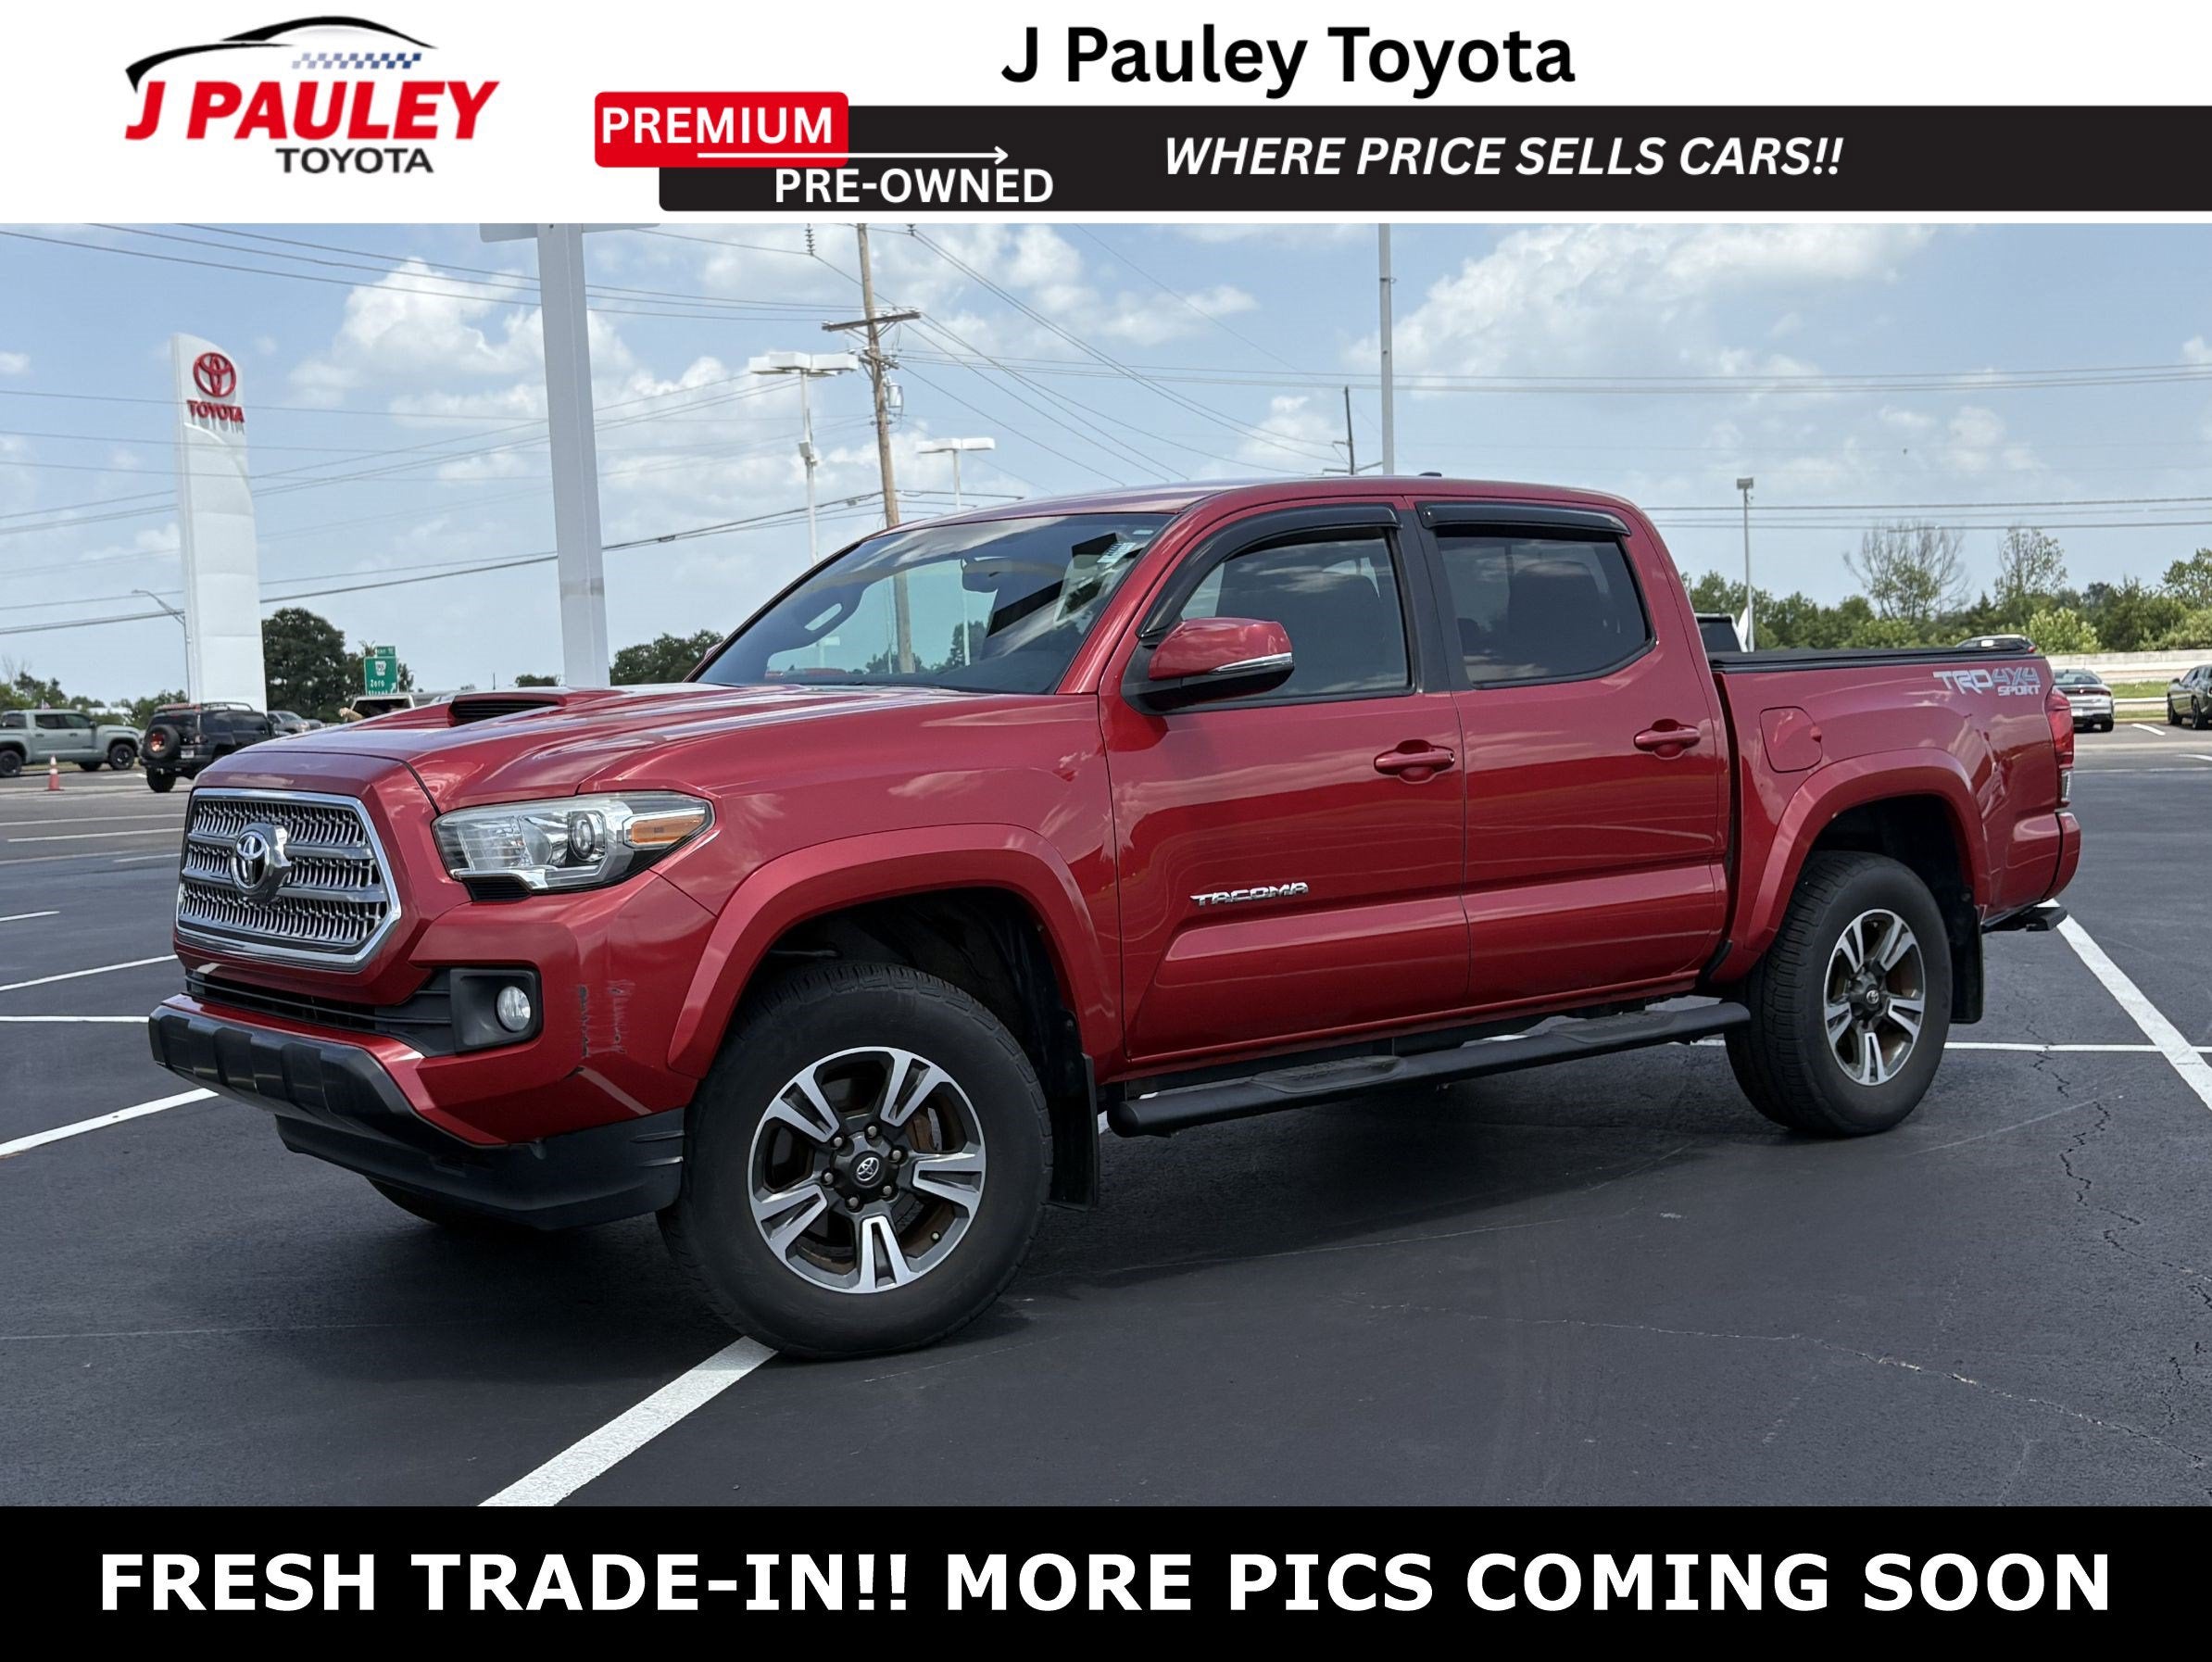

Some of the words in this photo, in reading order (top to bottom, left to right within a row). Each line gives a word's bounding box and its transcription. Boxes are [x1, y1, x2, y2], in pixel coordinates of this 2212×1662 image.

[186, 399, 245, 422] TOYOTA
[1932, 669, 1993, 695] TRD
[1997, 685, 2041, 696] SPORT
[1189, 882, 1309, 907] TACOMA
